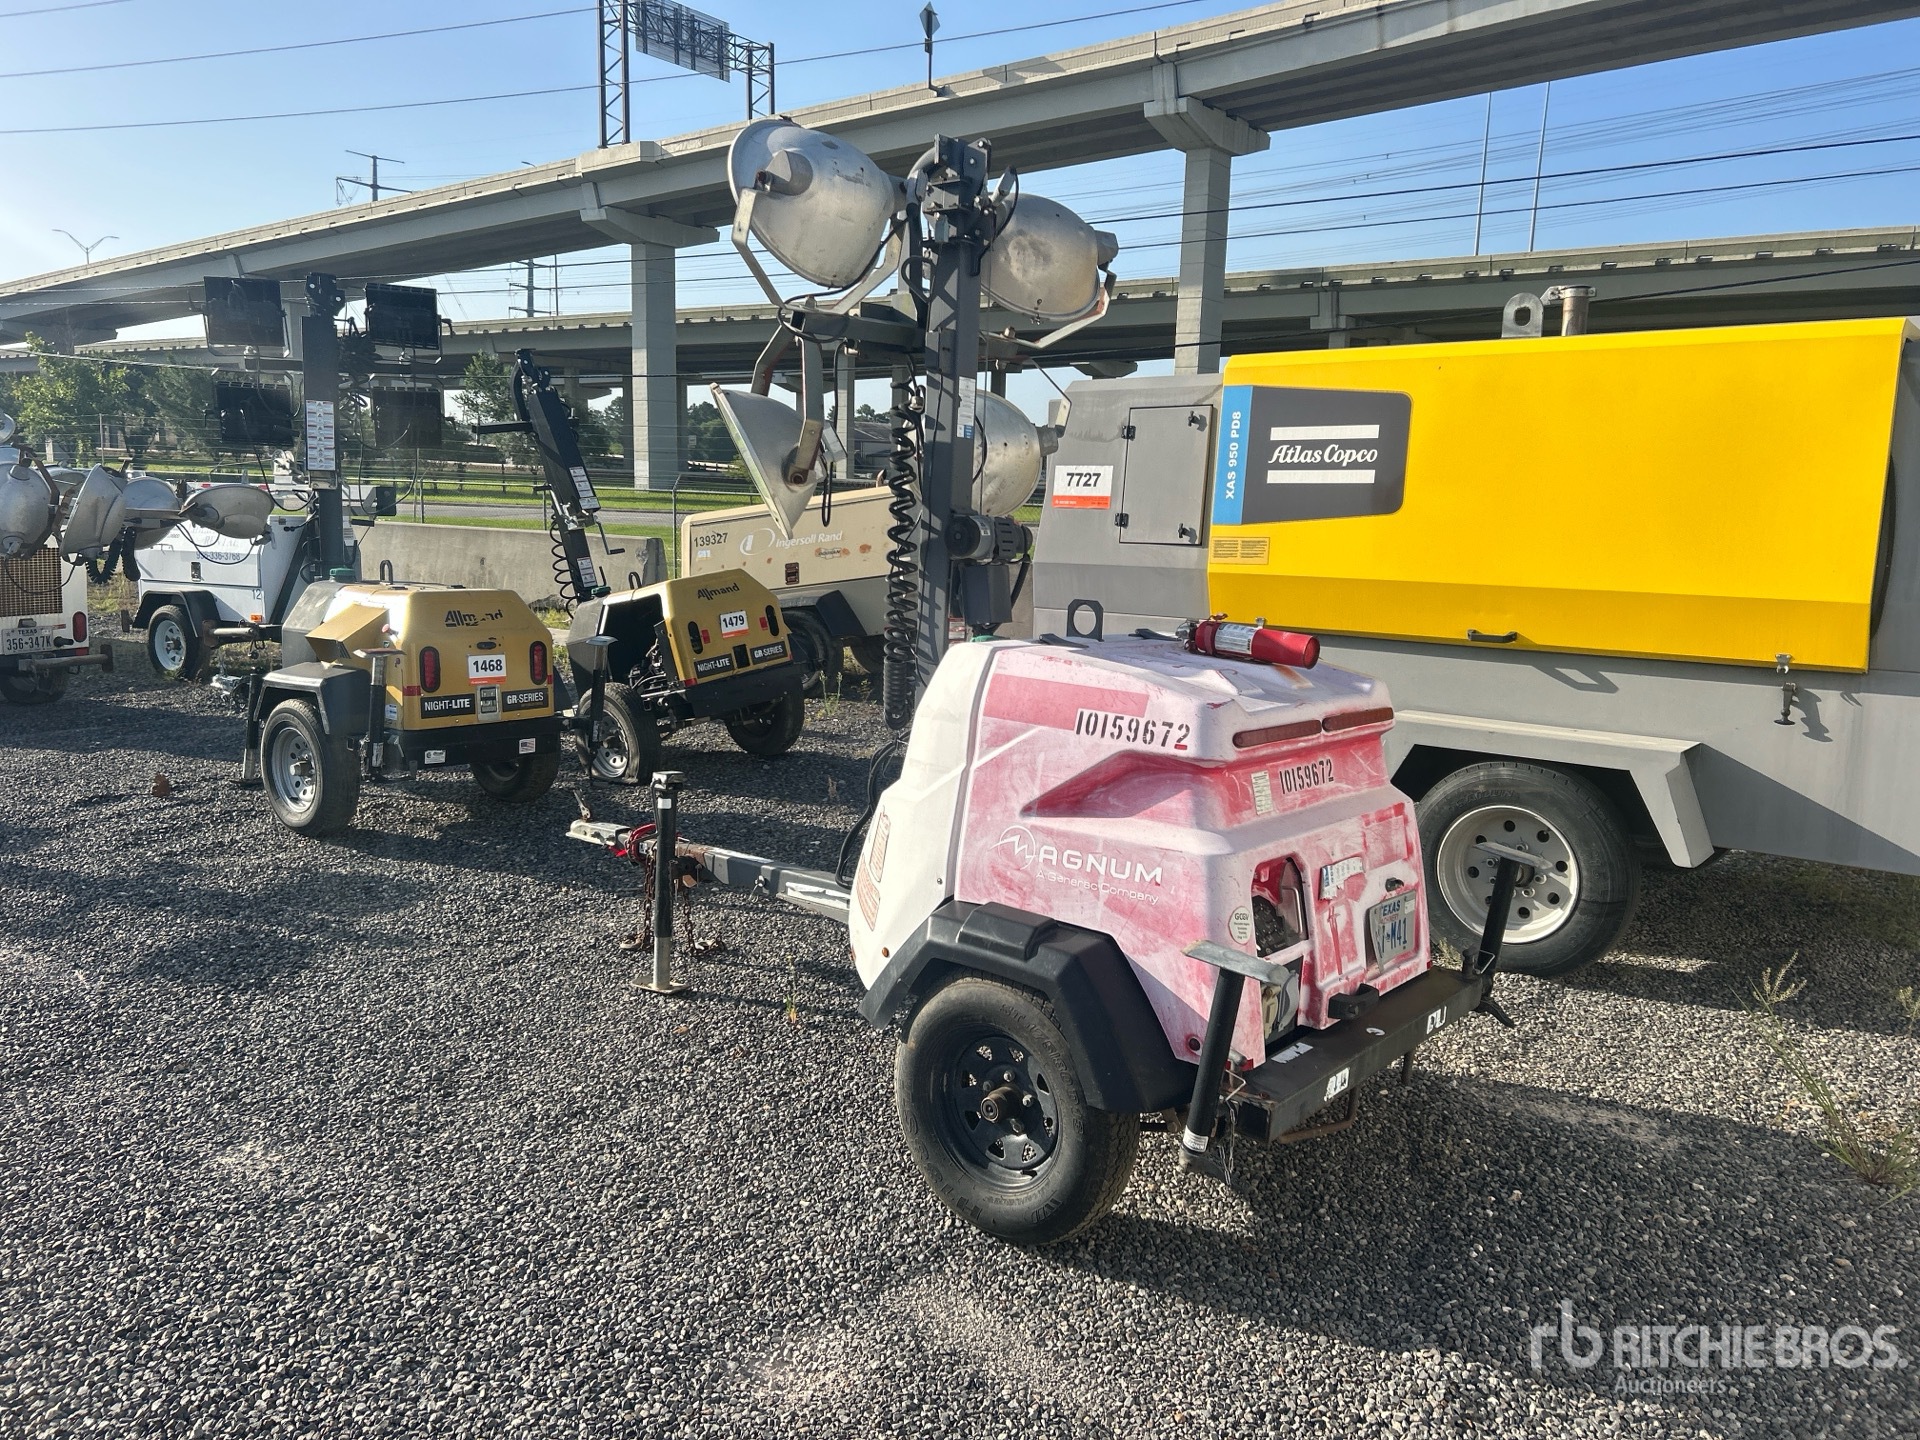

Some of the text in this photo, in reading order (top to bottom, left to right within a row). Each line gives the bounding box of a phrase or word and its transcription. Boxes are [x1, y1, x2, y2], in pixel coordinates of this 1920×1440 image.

[1225, 411, 1242, 499] XAS 950 PD8
[1268, 444, 1378, 467] Atlas Copco
[1066, 472, 1101, 487] 7727
[693, 532, 728, 549] 139327
[775, 530, 843, 549] Ingersoll Rand
[697, 583, 740, 600] Allmand
[722, 614, 745, 628] 1479
[754, 645, 783, 658] GR-SERIES
[473, 659, 503, 673] 1468
[697, 658, 731, 672] NIGHT-LITE
[424, 698, 471, 711] NIGHT-LITE
[507, 692, 544, 705] GR-SERIES
[1075, 711, 1191, 750] 10159672
[1279, 758, 1334, 795] 10159672
[1036, 869, 1159, 905] A Generac Company
